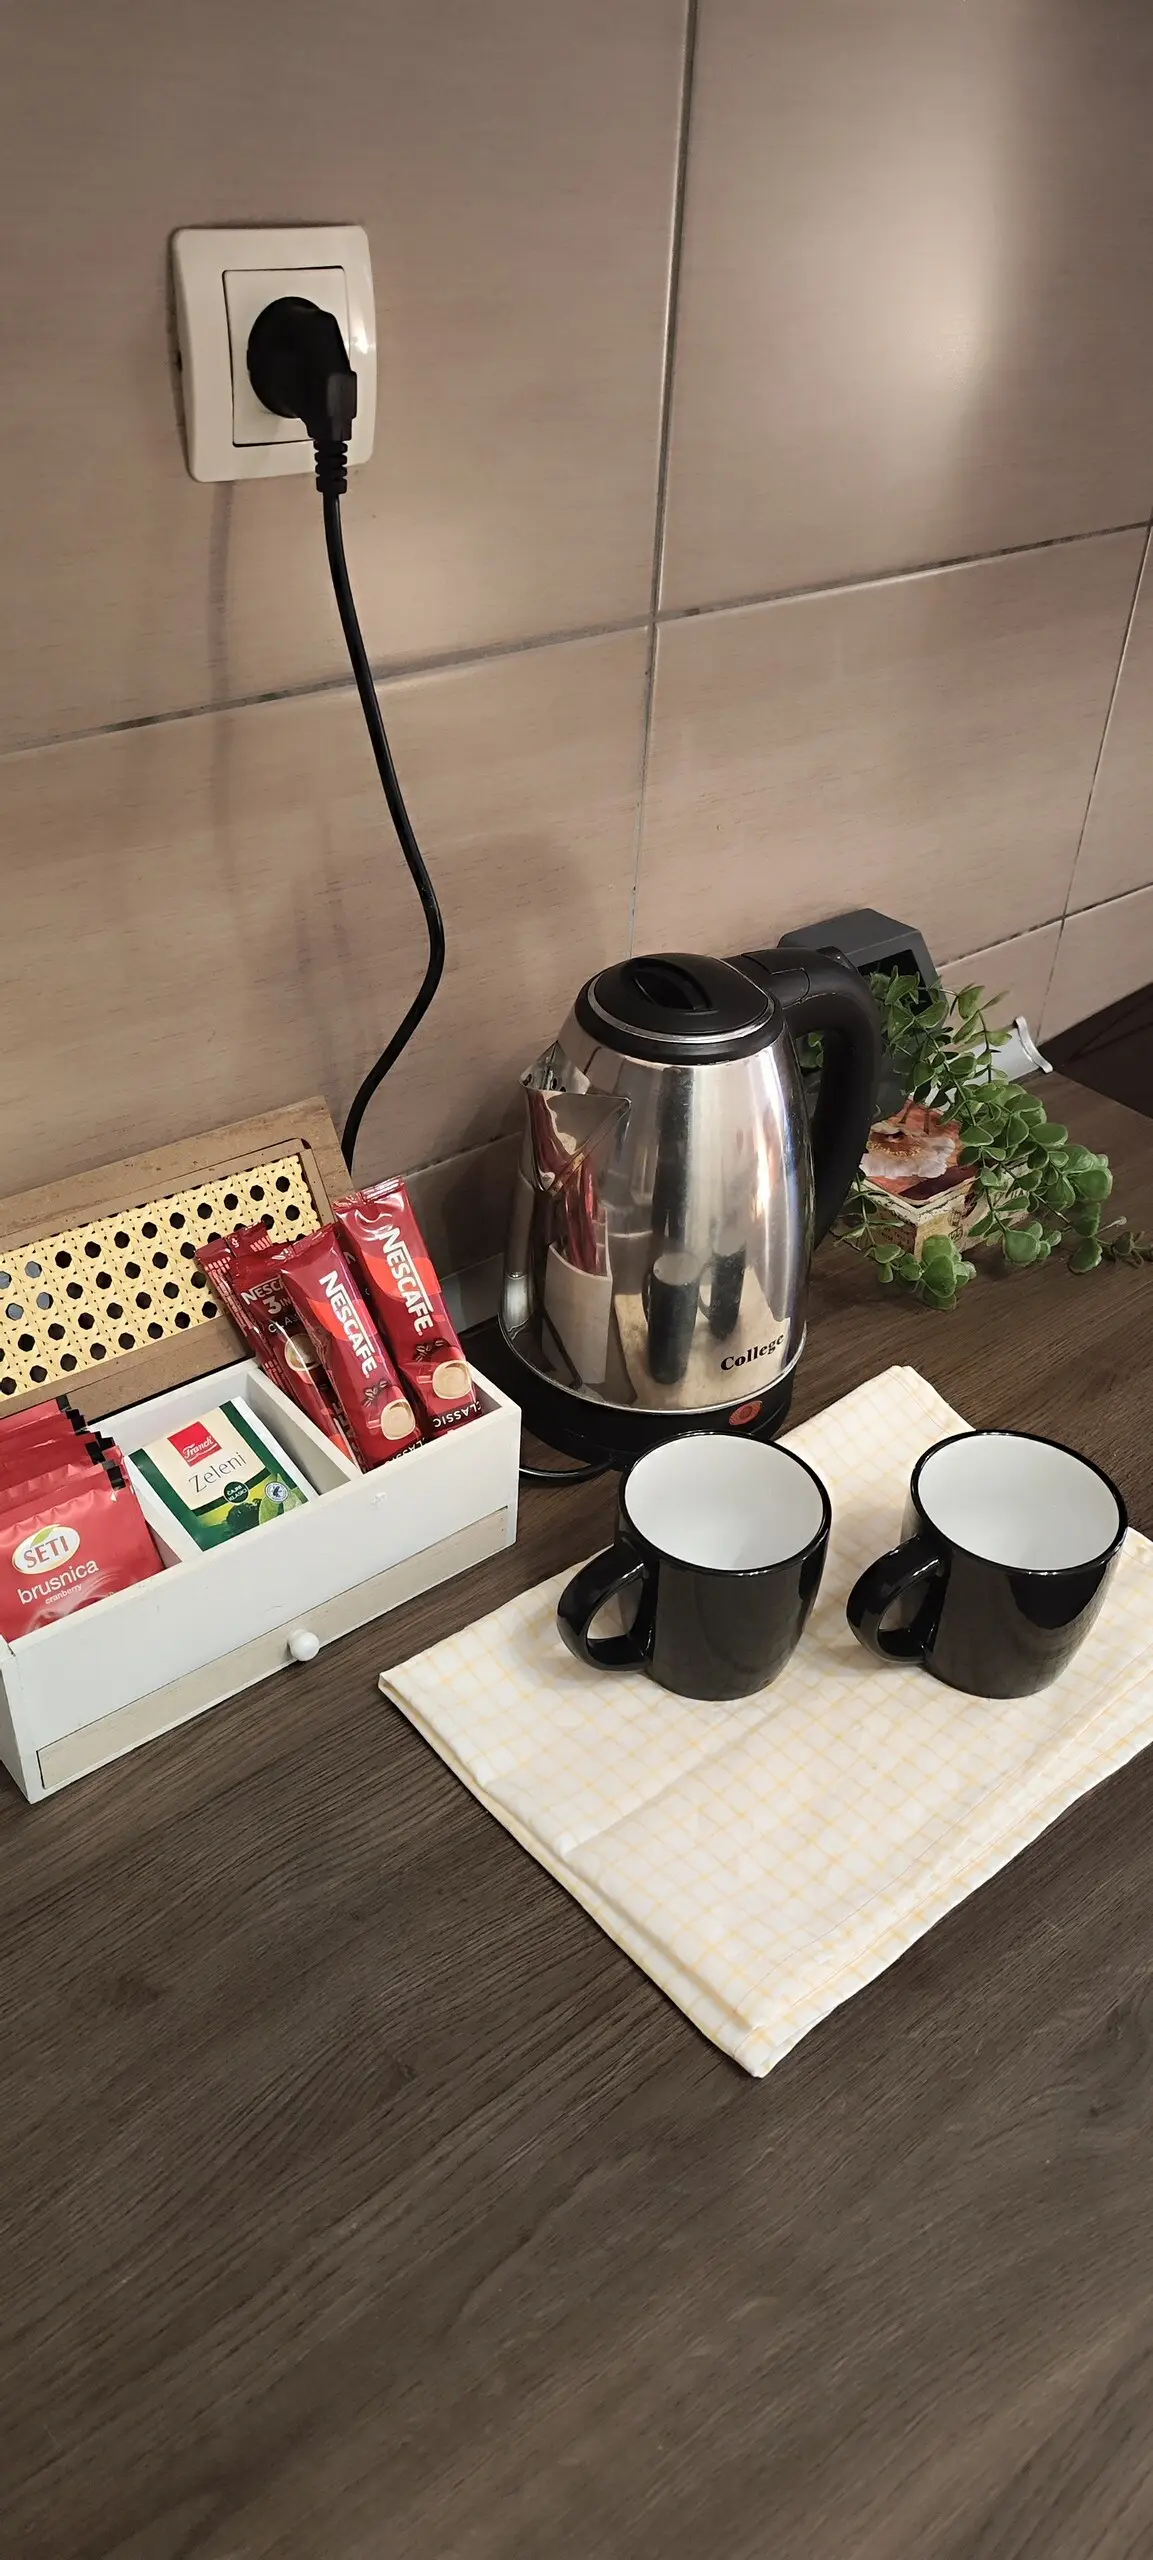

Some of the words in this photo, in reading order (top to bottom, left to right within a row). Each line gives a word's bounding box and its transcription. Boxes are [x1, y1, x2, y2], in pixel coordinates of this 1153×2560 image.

[720, 1334, 784, 1371] College
[432, 1400, 482, 1428] CLASSIC
[188, 1451, 247, 1493] Zeleni
[23, 1535, 69, 1568] SETI
[17, 1560, 99, 1604] brusnica
[45, 1583, 82, 1604] cranberry
